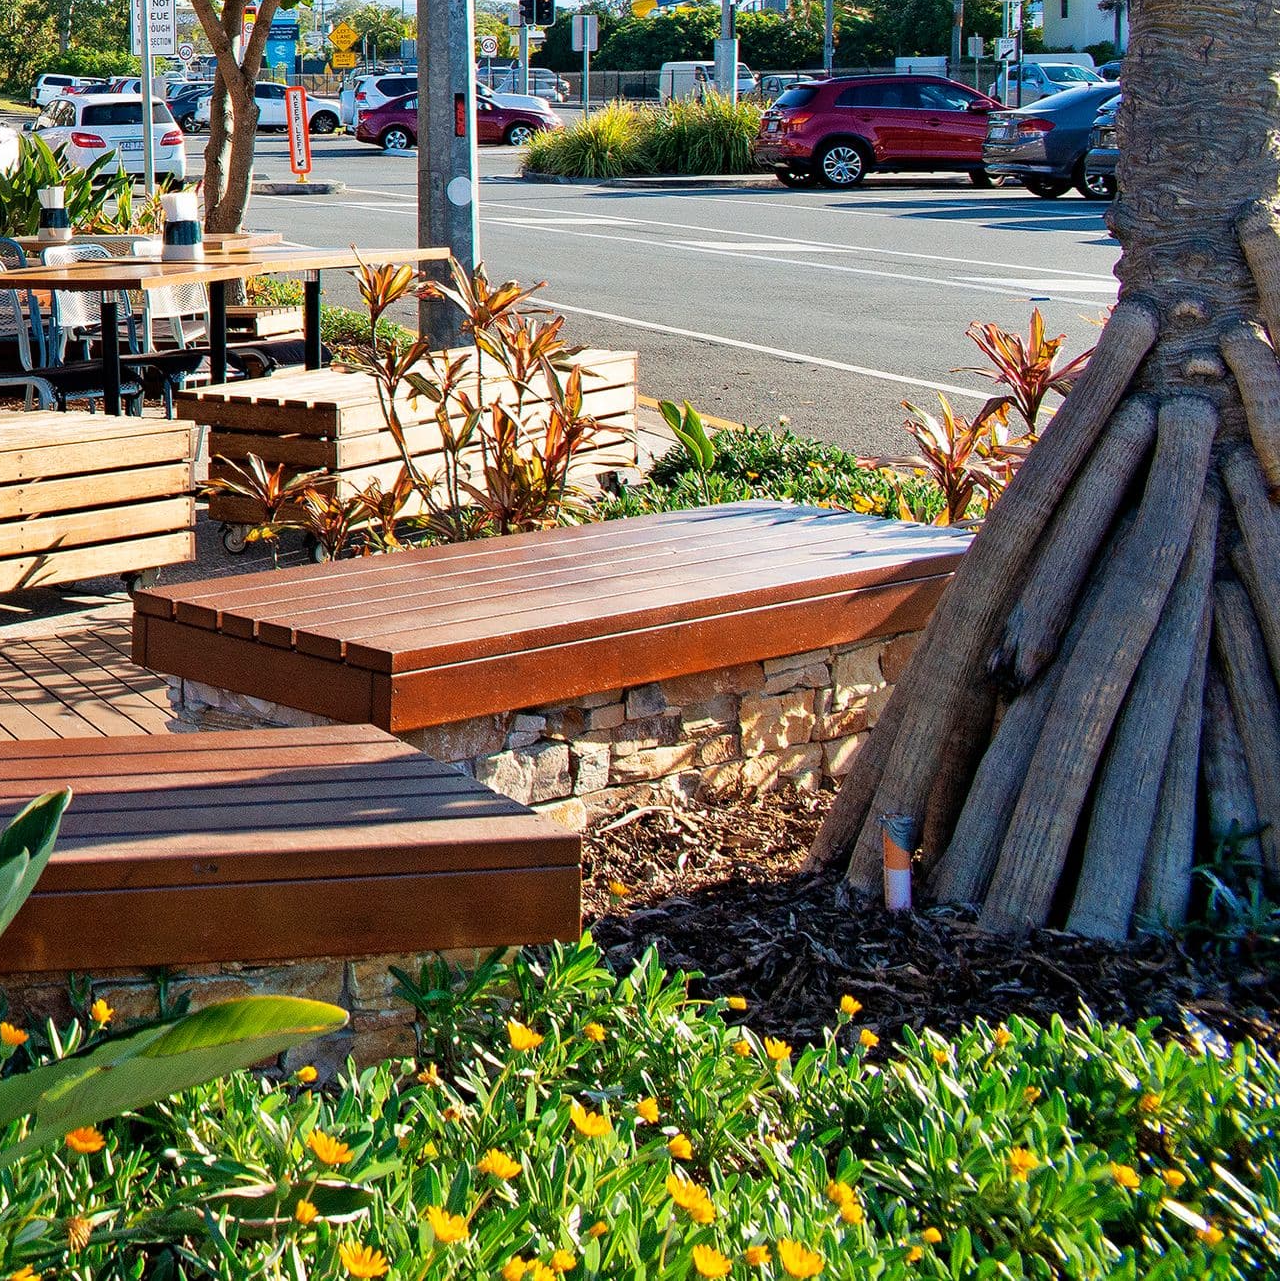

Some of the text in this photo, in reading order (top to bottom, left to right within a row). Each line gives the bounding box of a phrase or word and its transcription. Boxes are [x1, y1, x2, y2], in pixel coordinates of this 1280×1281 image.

[137, 25, 171, 33] TOUGH
[136, 37, 172, 46] INSECTION
[484, 42, 494, 50] 60
